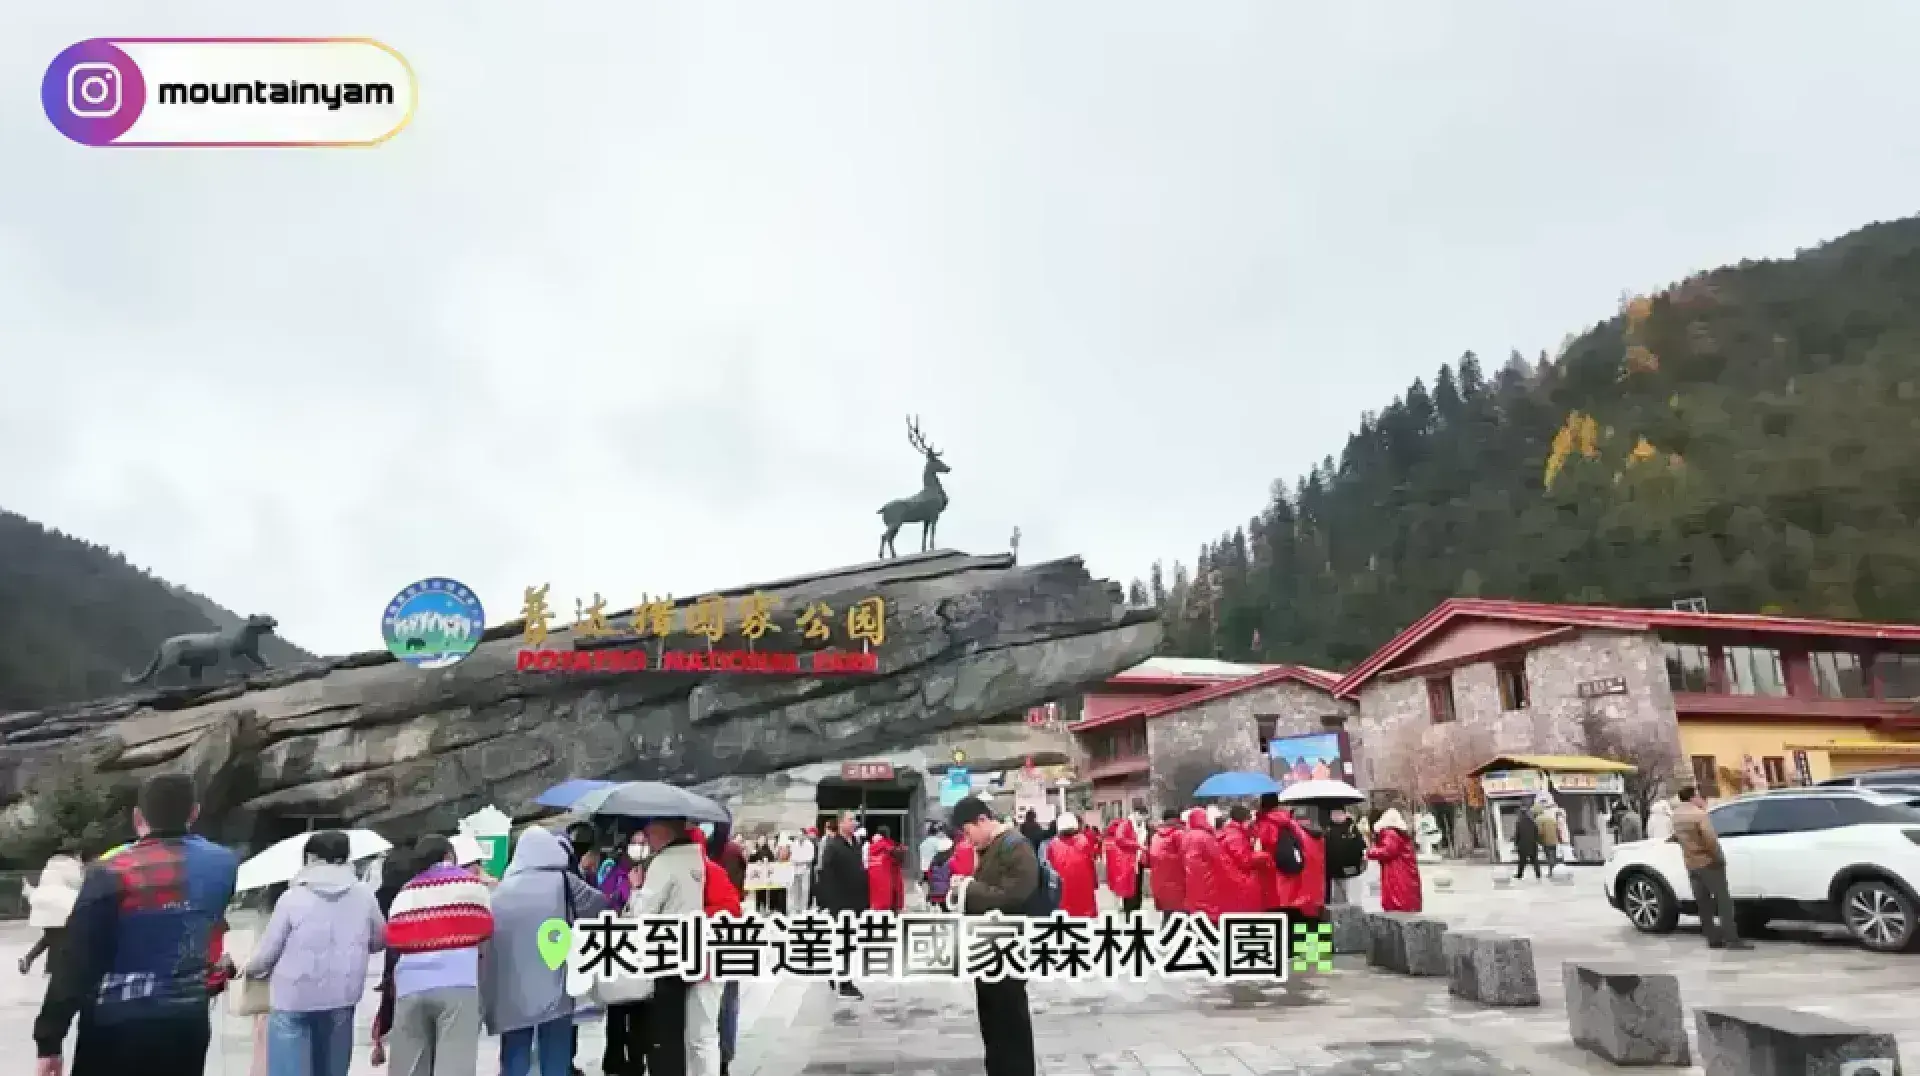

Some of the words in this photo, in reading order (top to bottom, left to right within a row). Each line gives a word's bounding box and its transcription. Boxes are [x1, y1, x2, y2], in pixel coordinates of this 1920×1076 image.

[520, 583, 886, 646] 普达措国家公园
